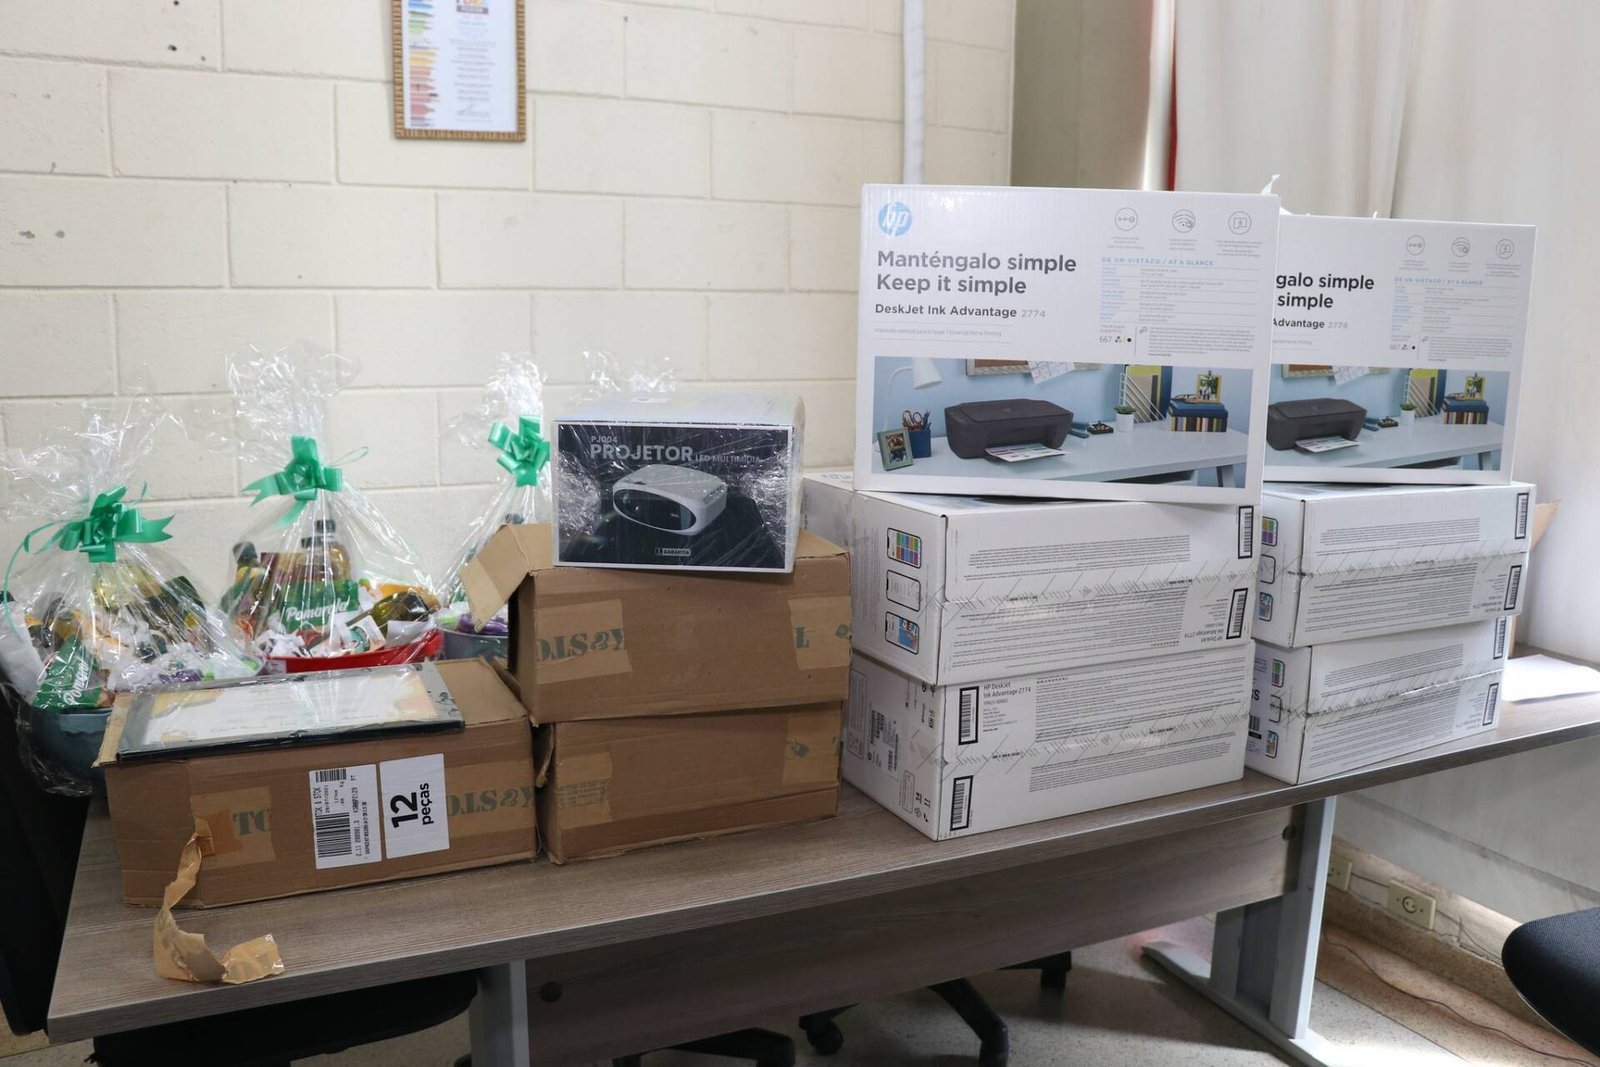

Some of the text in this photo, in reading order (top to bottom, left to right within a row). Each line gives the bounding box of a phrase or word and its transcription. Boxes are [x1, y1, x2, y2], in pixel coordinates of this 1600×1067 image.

[879, 202, 911, 236] hp
[877, 250, 1077, 273] Manténgalo simple
[876, 274, 1027, 296] Keep it simple
[1276, 273, 1375, 291] galo simple
[875, 304, 1046, 319] DeskJet Ink Advantage 2774
[1277, 294, 1334, 310] simple
[1273, 318, 1348, 330] Advantage 2774
[591, 435, 617, 443] PJ004
[590, 443, 694, 462] PROJETOR
[695, 454, 711, 462] LED
[390, 792, 418, 829] 12
[419, 782, 434, 826] peças
